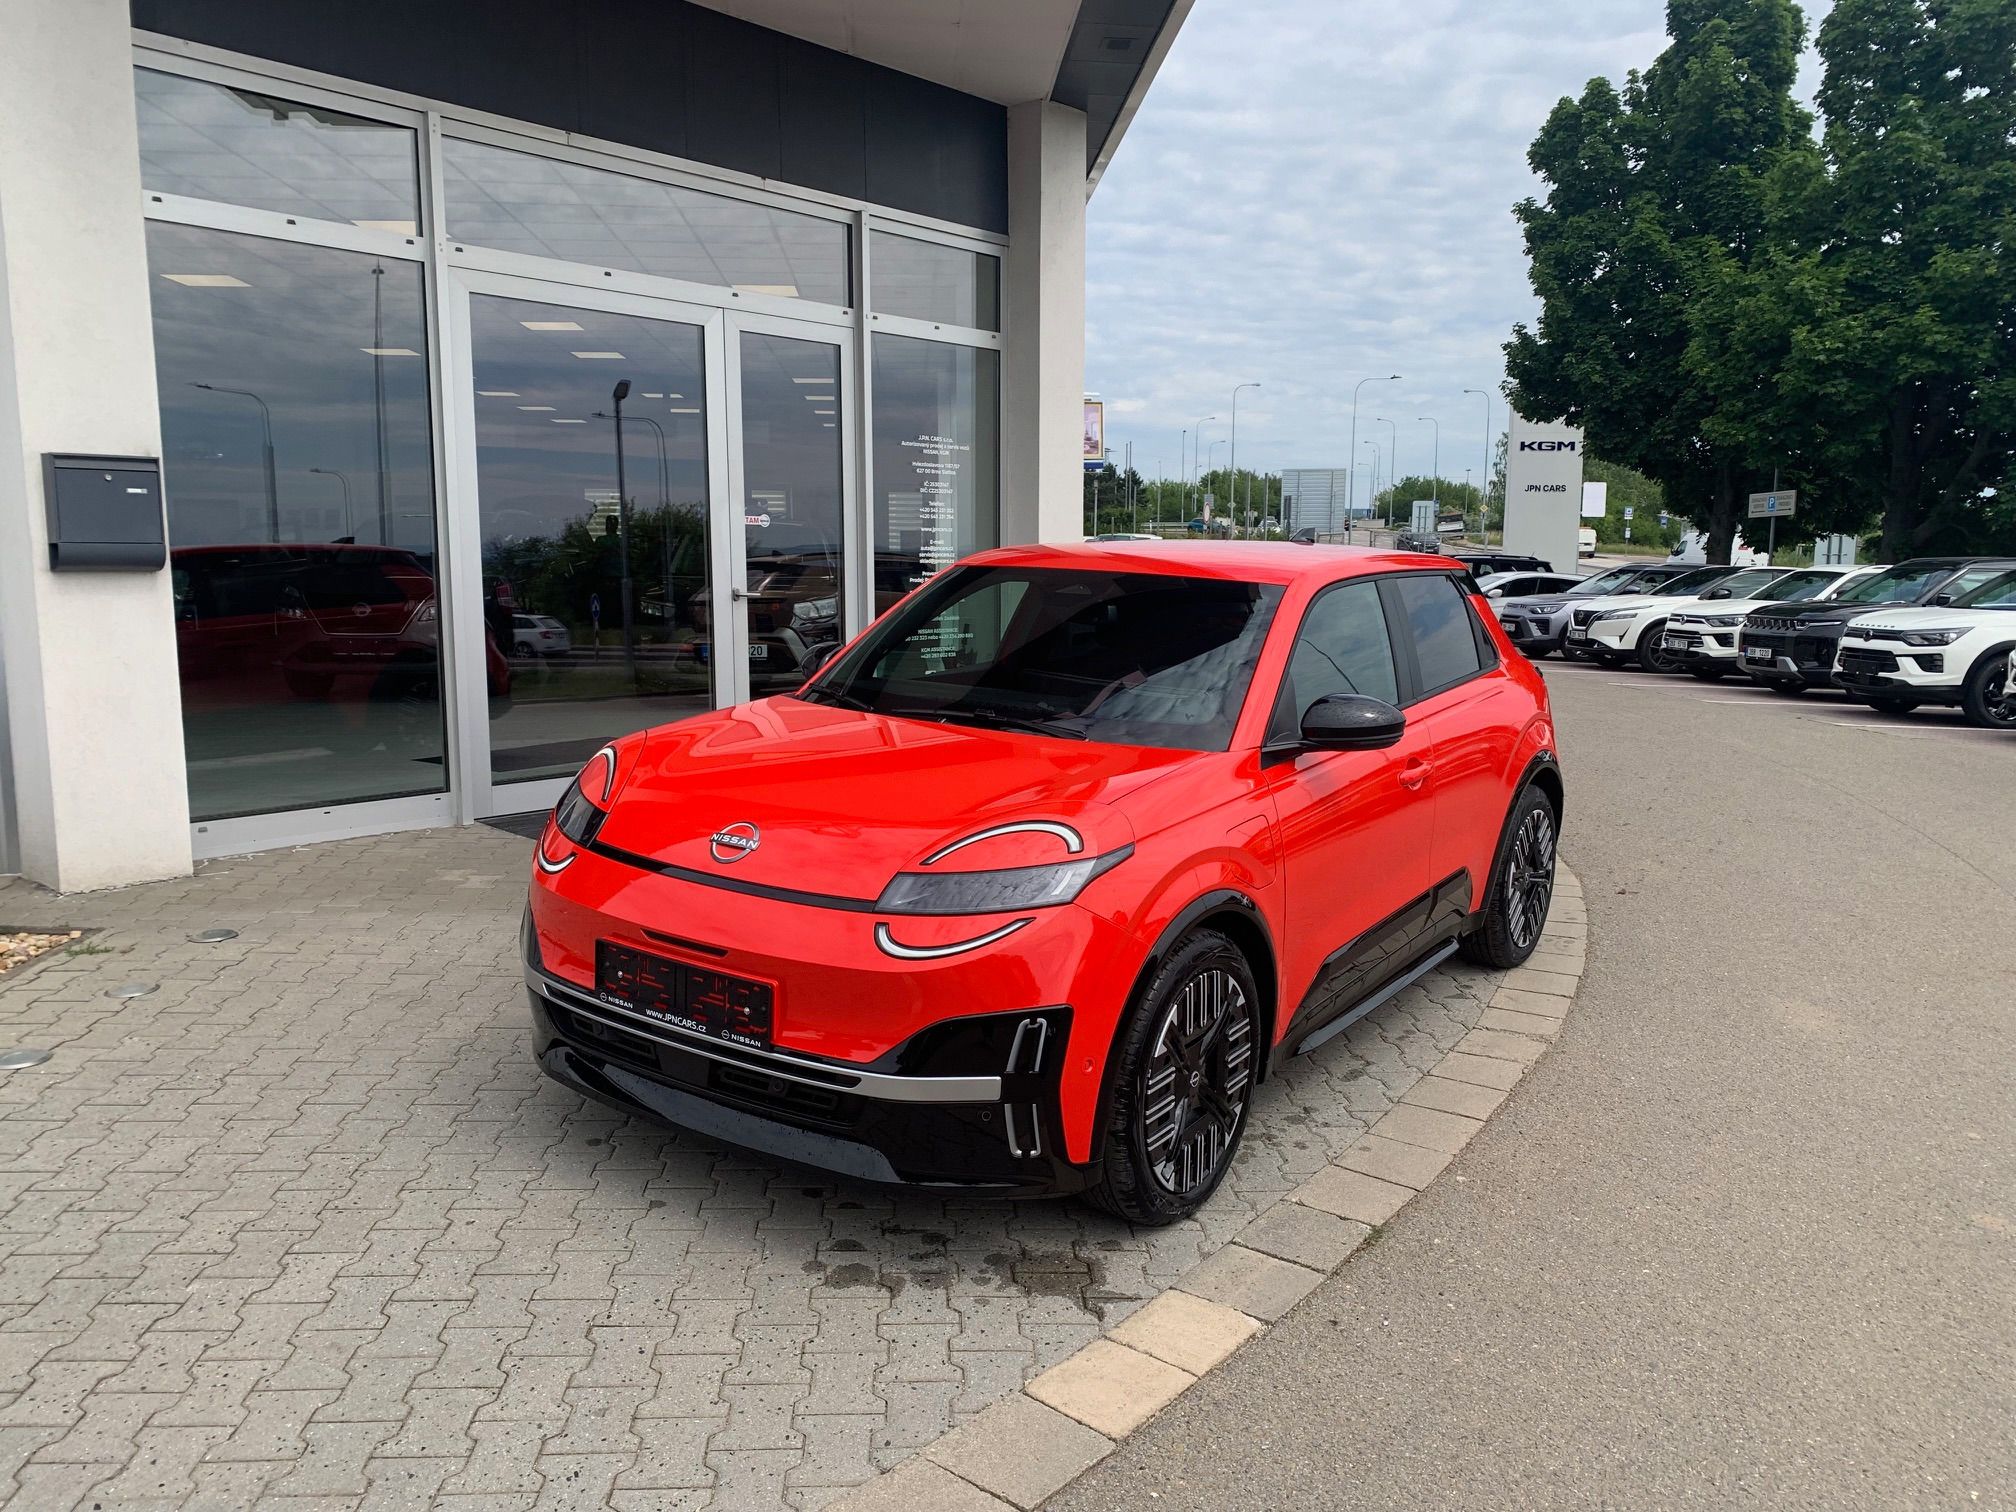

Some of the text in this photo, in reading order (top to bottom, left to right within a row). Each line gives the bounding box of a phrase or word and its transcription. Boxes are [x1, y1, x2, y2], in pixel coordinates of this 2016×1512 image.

[1520, 442, 1576, 451] KGM
[750, 646, 763, 656] 20
[711, 834, 758, 849] NISSAN
[608, 996, 633, 1008] NISSAN
[645, 1008, 706, 1033] www.JPNCARS.cz
[731, 1033, 761, 1048] NISSAN
